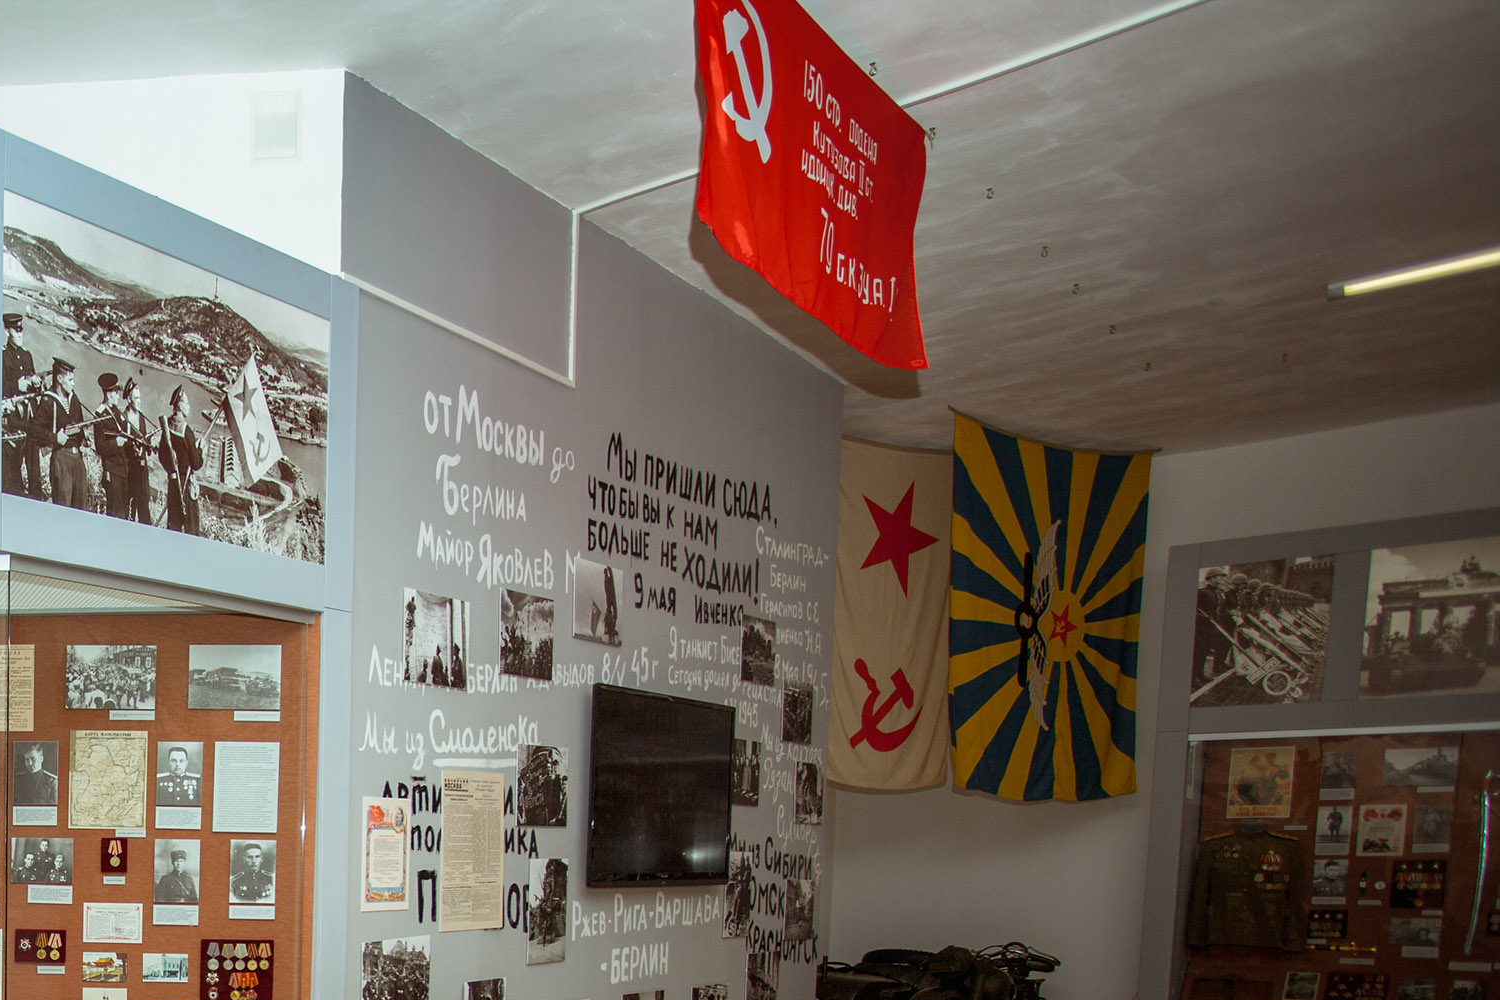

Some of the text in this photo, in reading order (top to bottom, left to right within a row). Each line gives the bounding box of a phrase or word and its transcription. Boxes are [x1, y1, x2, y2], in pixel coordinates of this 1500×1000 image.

[804, 59, 823, 111] 150
[550, 447, 575, 484] до
[644, 454, 716, 509] ПРИШЛИ
[666, 504, 675, 529] К
[684, 510, 718, 551] НАМ
[588, 518, 760, 605] БОЛЬШЕ НЕ ХОДИЛИ!
[634, 572, 676, 616] 9 МАЯ
[668, 626, 678, 661] Я
[738, 701, 758, 728] 1945
[358, 709, 541, 771] Мы из Смоленска
